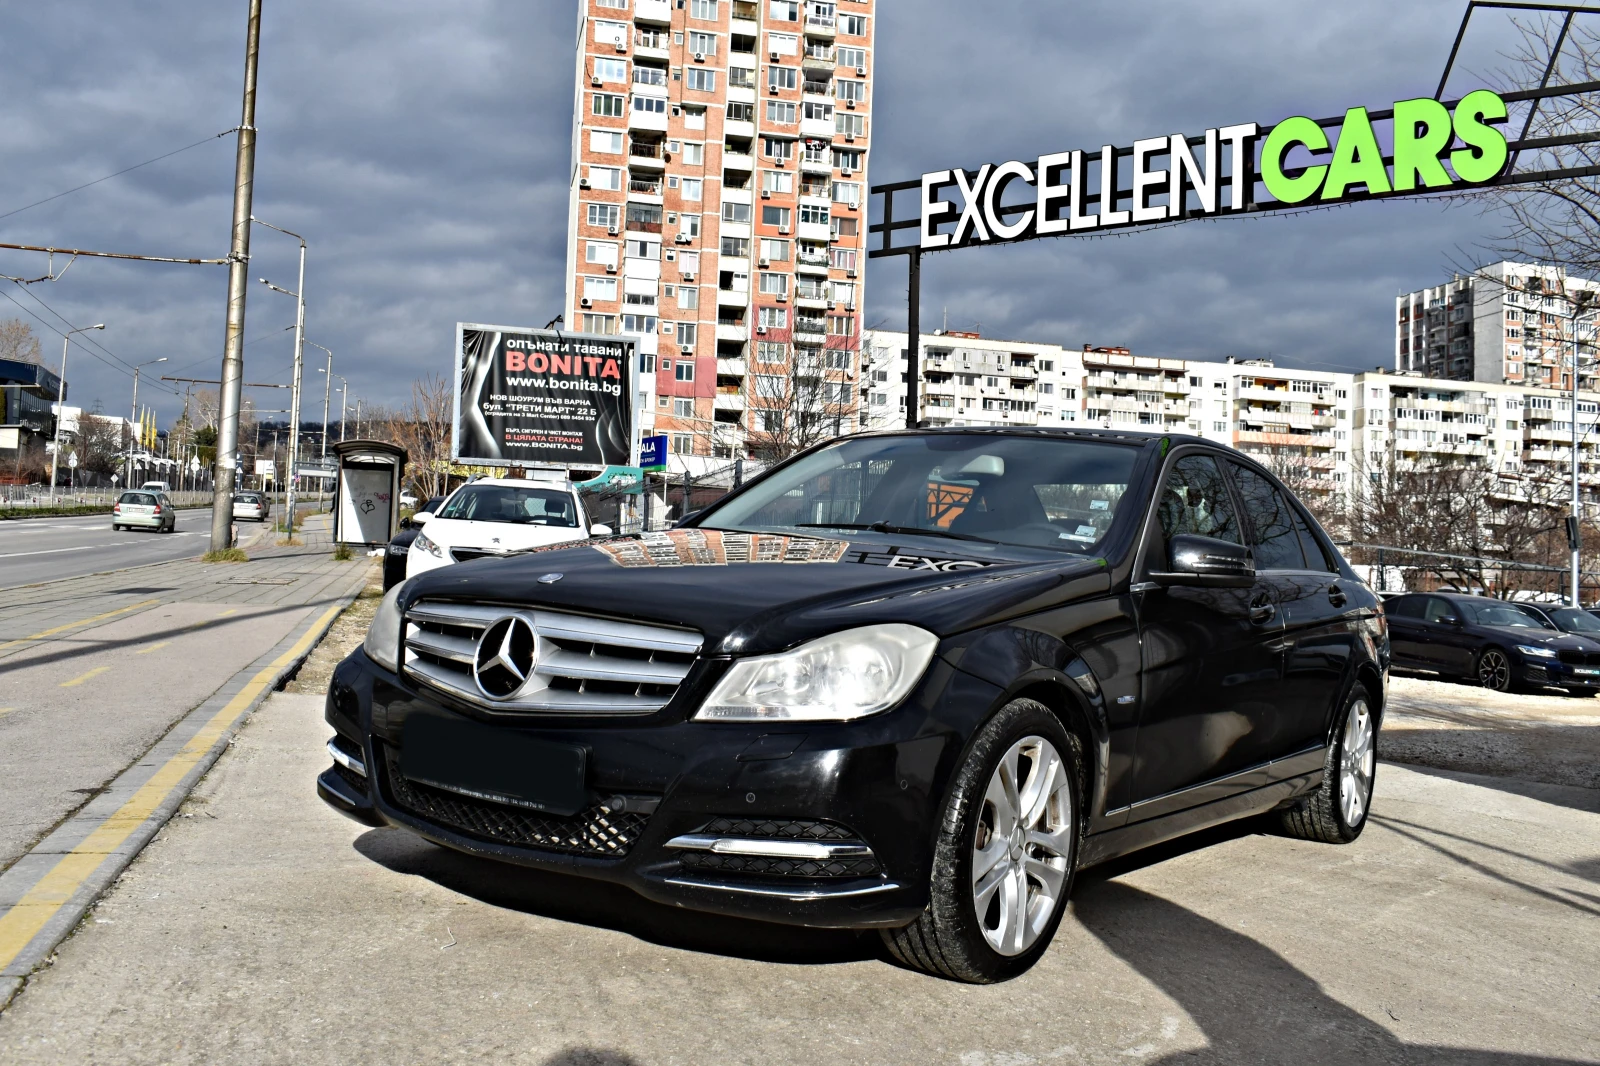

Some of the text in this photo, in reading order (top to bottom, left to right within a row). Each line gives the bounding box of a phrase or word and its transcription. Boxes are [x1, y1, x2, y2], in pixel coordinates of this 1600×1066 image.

[921, 89, 1508, 249] EXCELLENT CARS
[506, 339, 622, 356] опънати тавани
[506, 351, 621, 379] BONITA
[506, 377, 622, 396] www.bonita.bg
[506, 442, 583, 451] www.BONITA.bg
